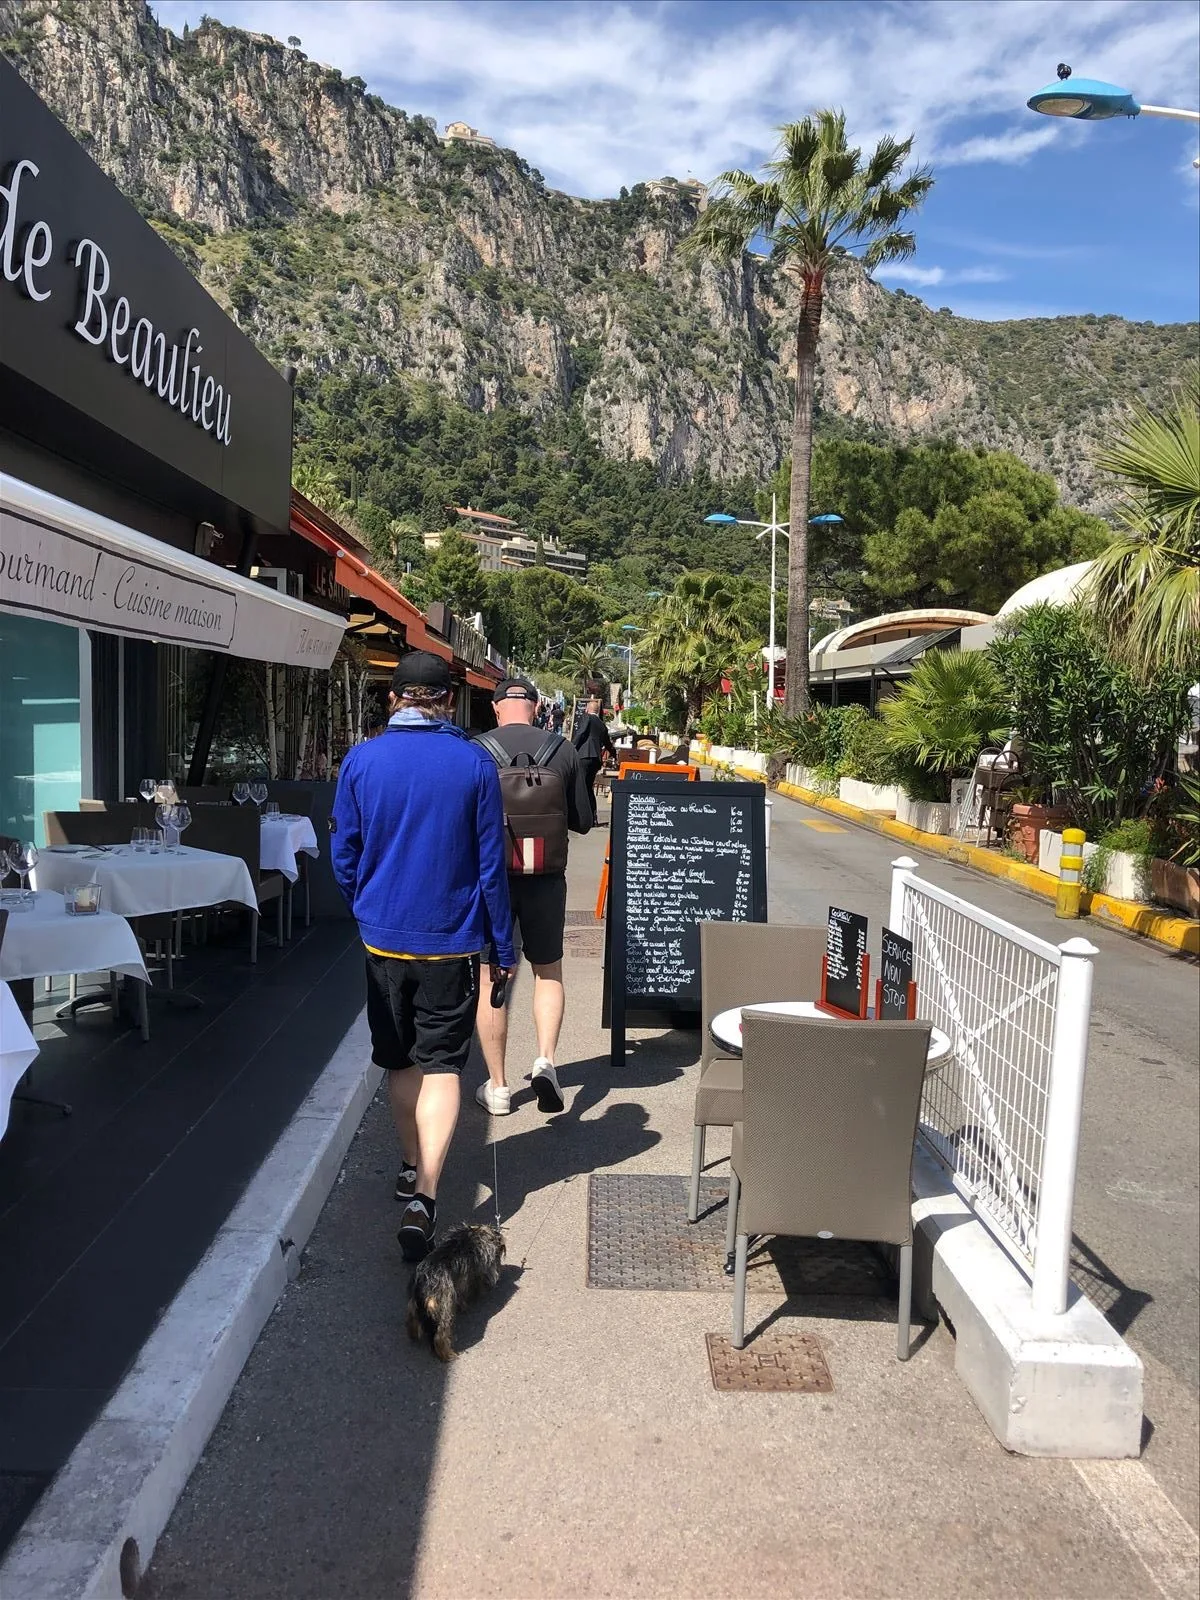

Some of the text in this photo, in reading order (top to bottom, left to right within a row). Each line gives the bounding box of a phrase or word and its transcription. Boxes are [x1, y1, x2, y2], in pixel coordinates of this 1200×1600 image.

[75, 238, 233, 448] Beaulieu
[113, 565, 171, 621] Cuisine
[174, 599, 222, 631] maison
[883, 960, 902, 985] NON
[882, 983, 906, 1012] STOP
